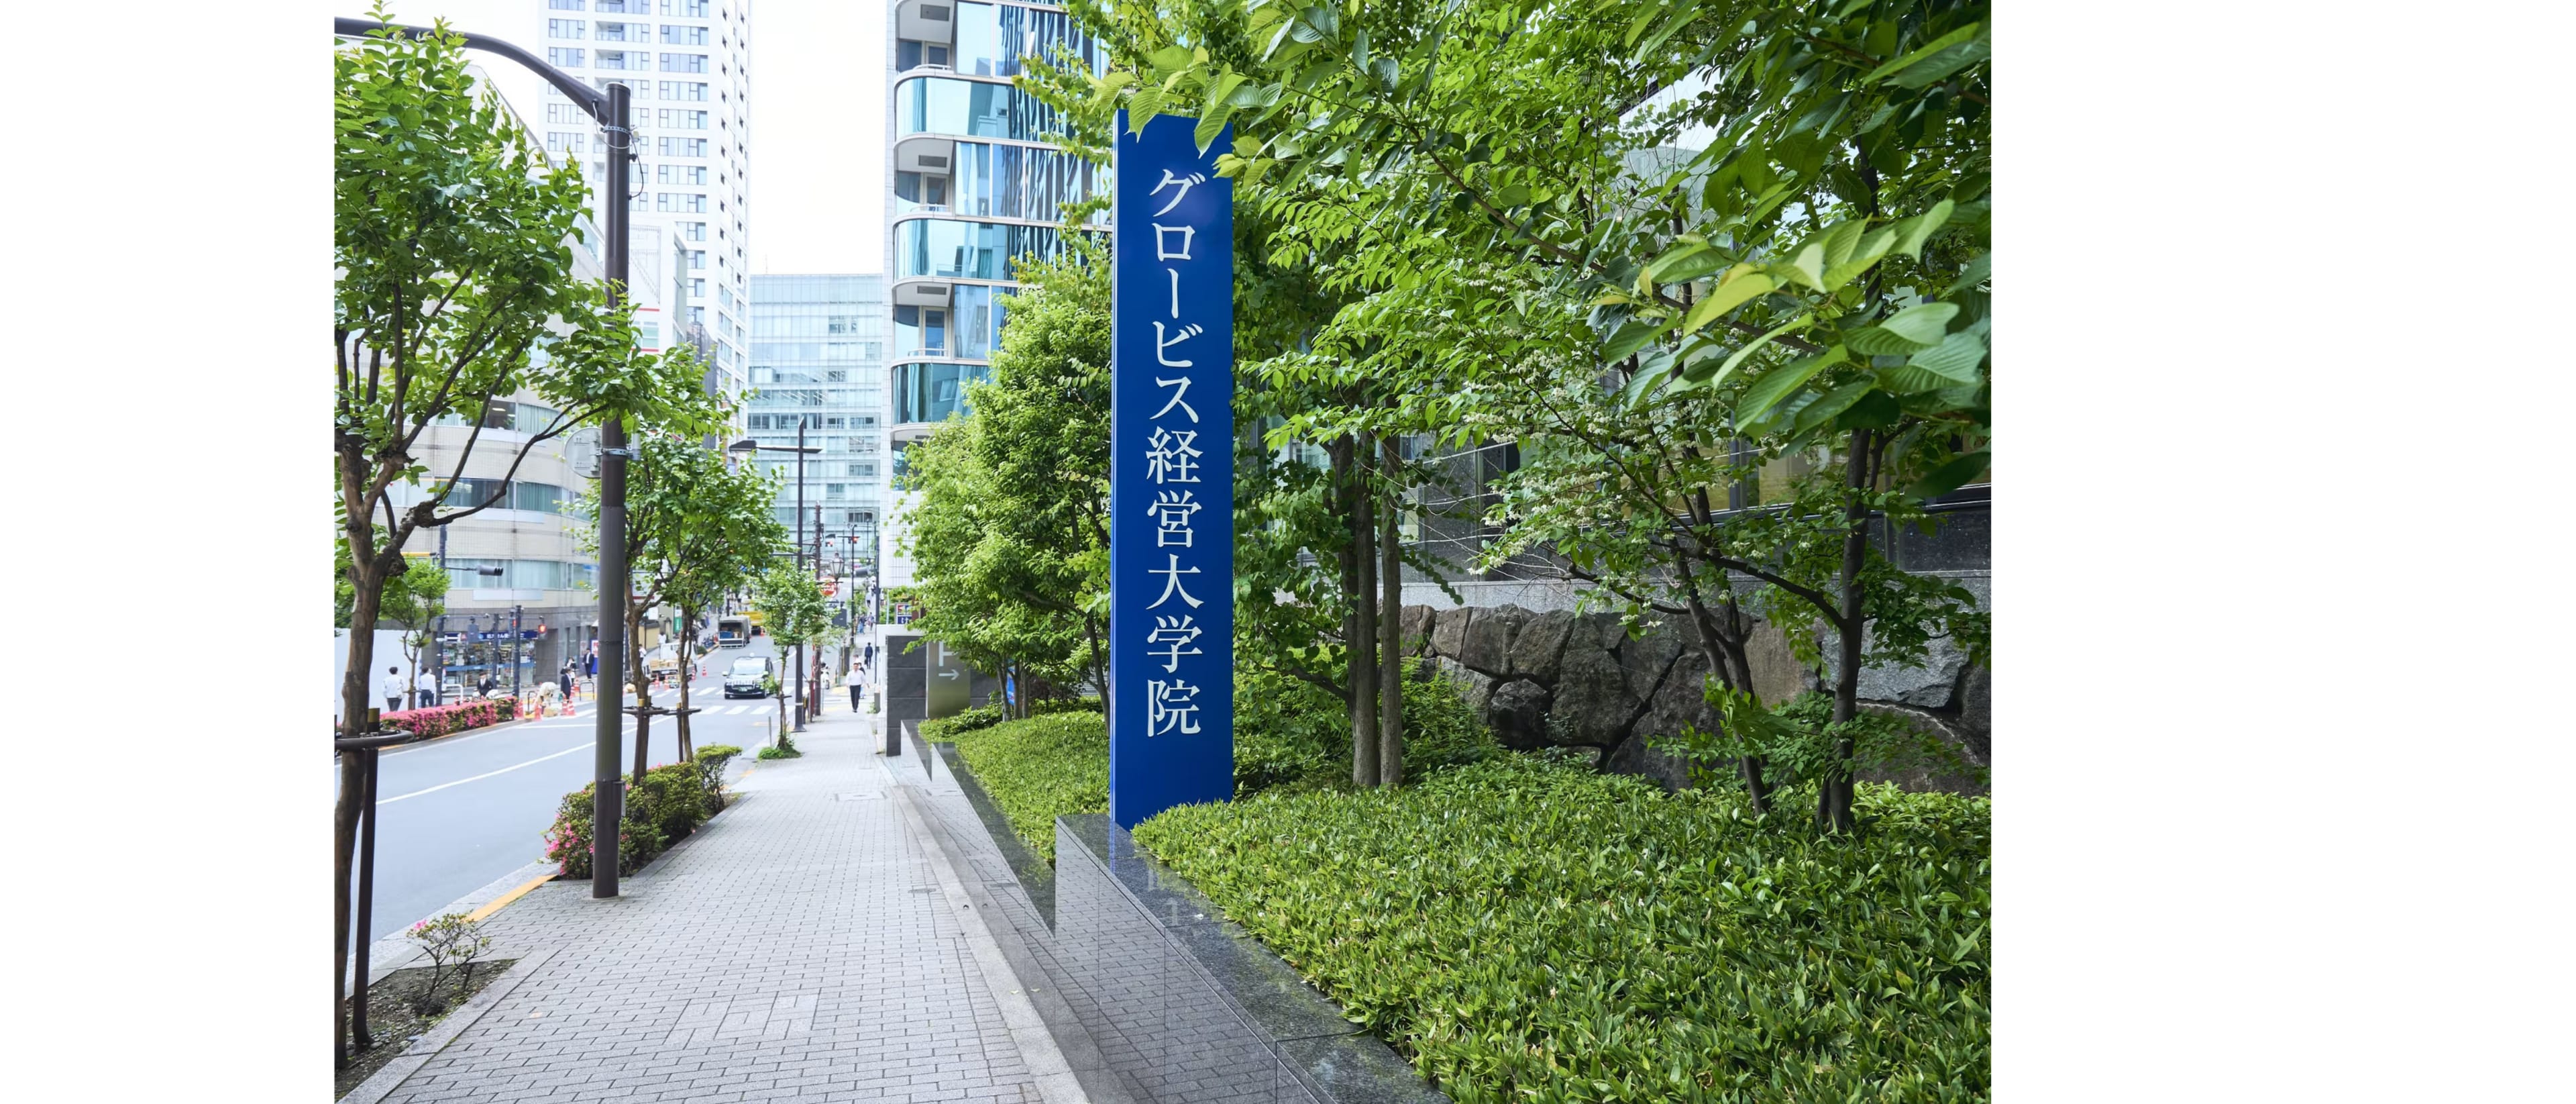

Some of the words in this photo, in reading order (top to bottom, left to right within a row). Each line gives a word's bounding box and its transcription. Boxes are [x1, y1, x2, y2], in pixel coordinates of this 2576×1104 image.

[1145, 168, 1205, 737] グロービス経営大学院
